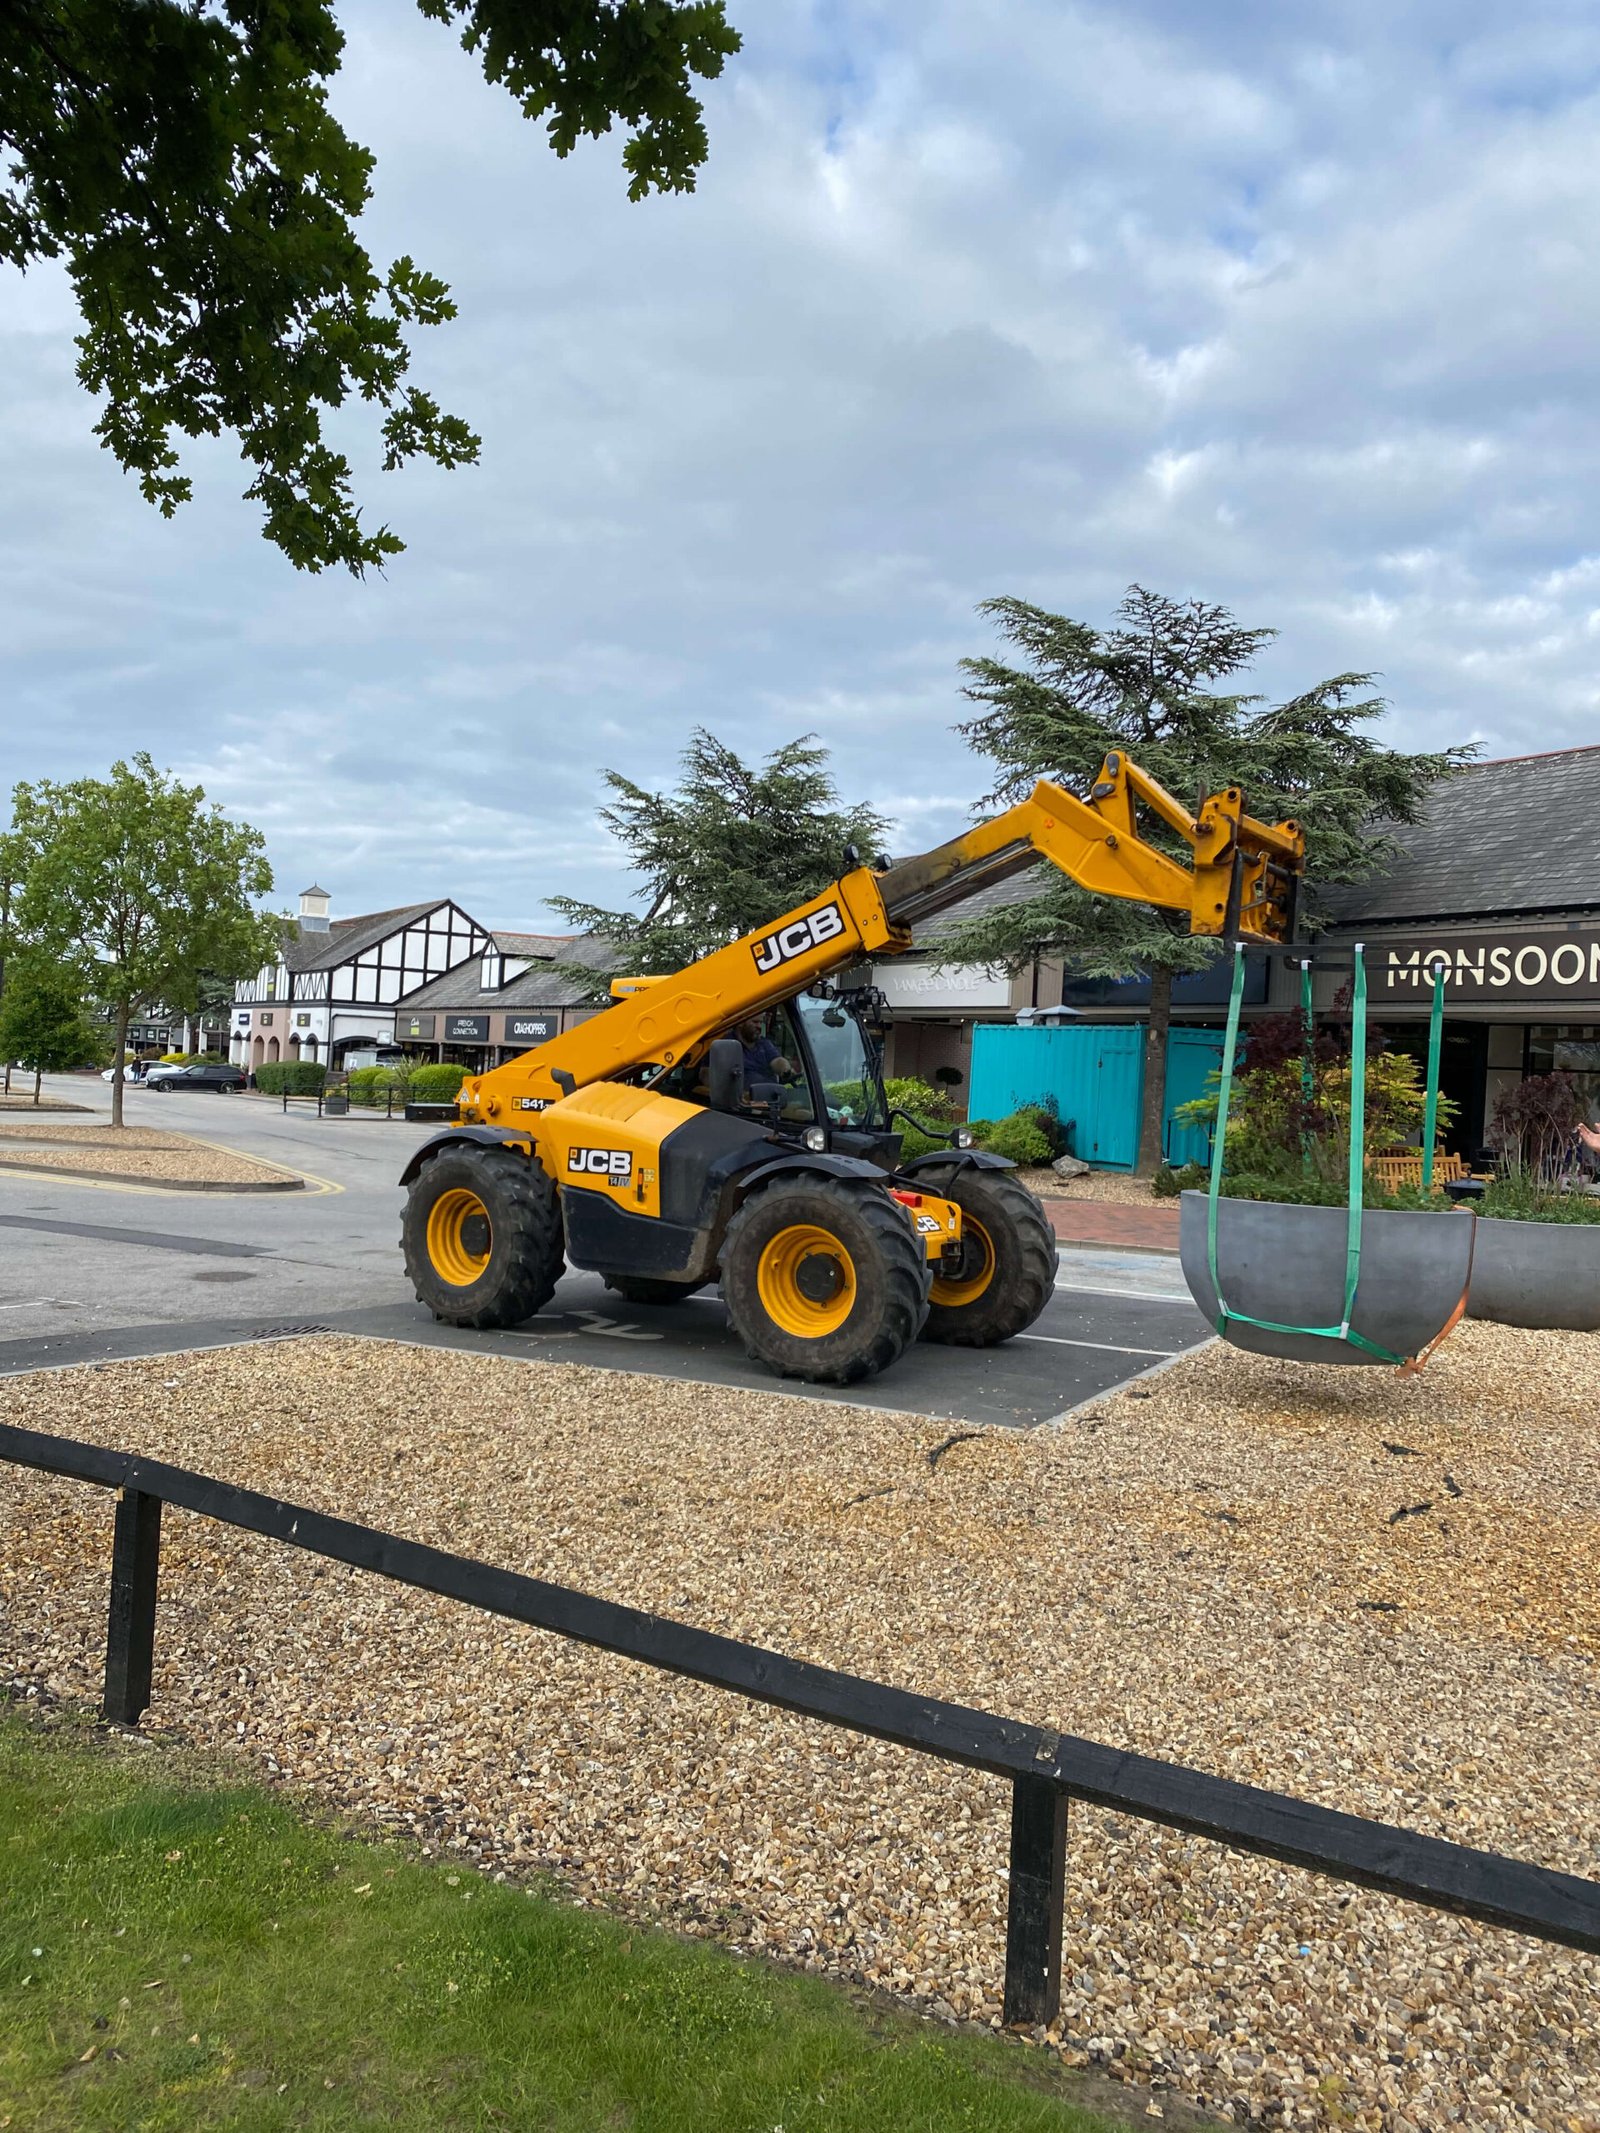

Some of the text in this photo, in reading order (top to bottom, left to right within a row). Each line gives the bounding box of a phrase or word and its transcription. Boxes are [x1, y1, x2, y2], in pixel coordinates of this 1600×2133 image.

[757, 906, 843, 971] JCB
[569, 1149, 631, 1175] JCB
[917, 1216, 940, 1232] CB
